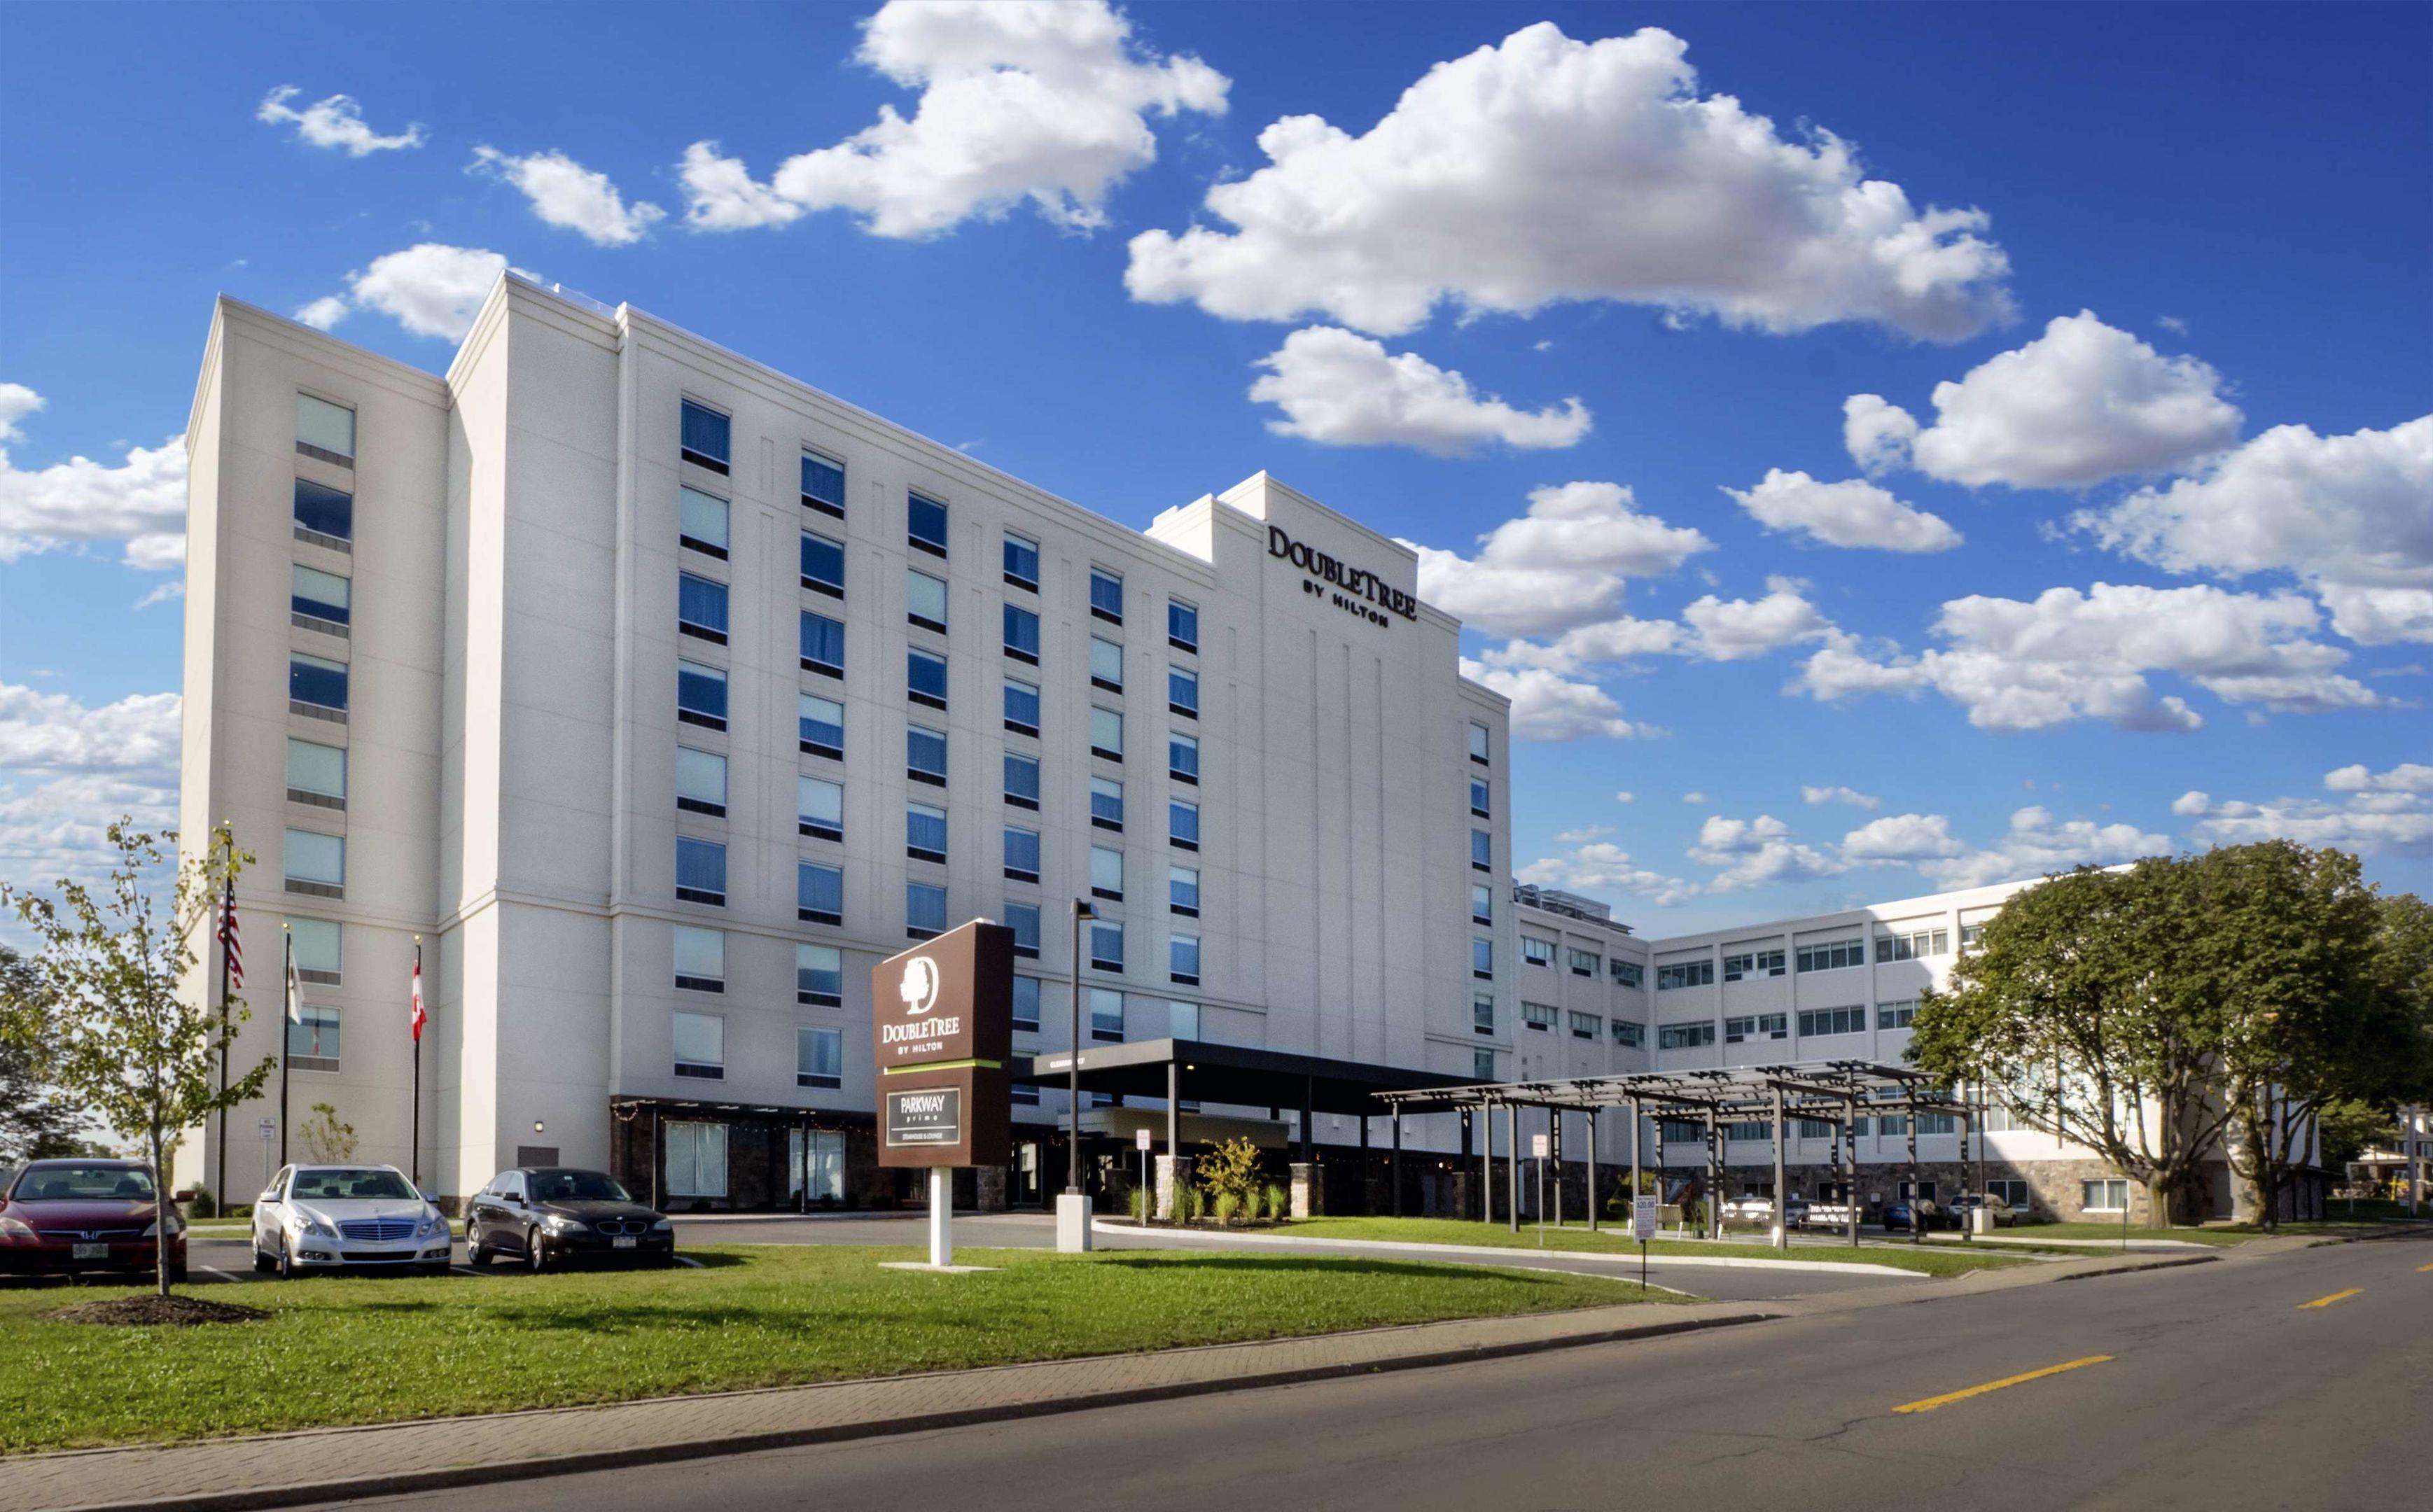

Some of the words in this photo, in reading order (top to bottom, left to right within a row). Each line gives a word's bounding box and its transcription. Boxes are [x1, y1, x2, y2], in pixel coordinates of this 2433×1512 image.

[1303, 579, 1325, 598] BY
[1332, 593, 1389, 628] HILTON
[898, 1046, 909, 1055] BY
[912, 1042, 943, 1053] HILTON
[900, 1095, 945, 1114] PARKWAY
[906, 1114, 938, 1124] prime
